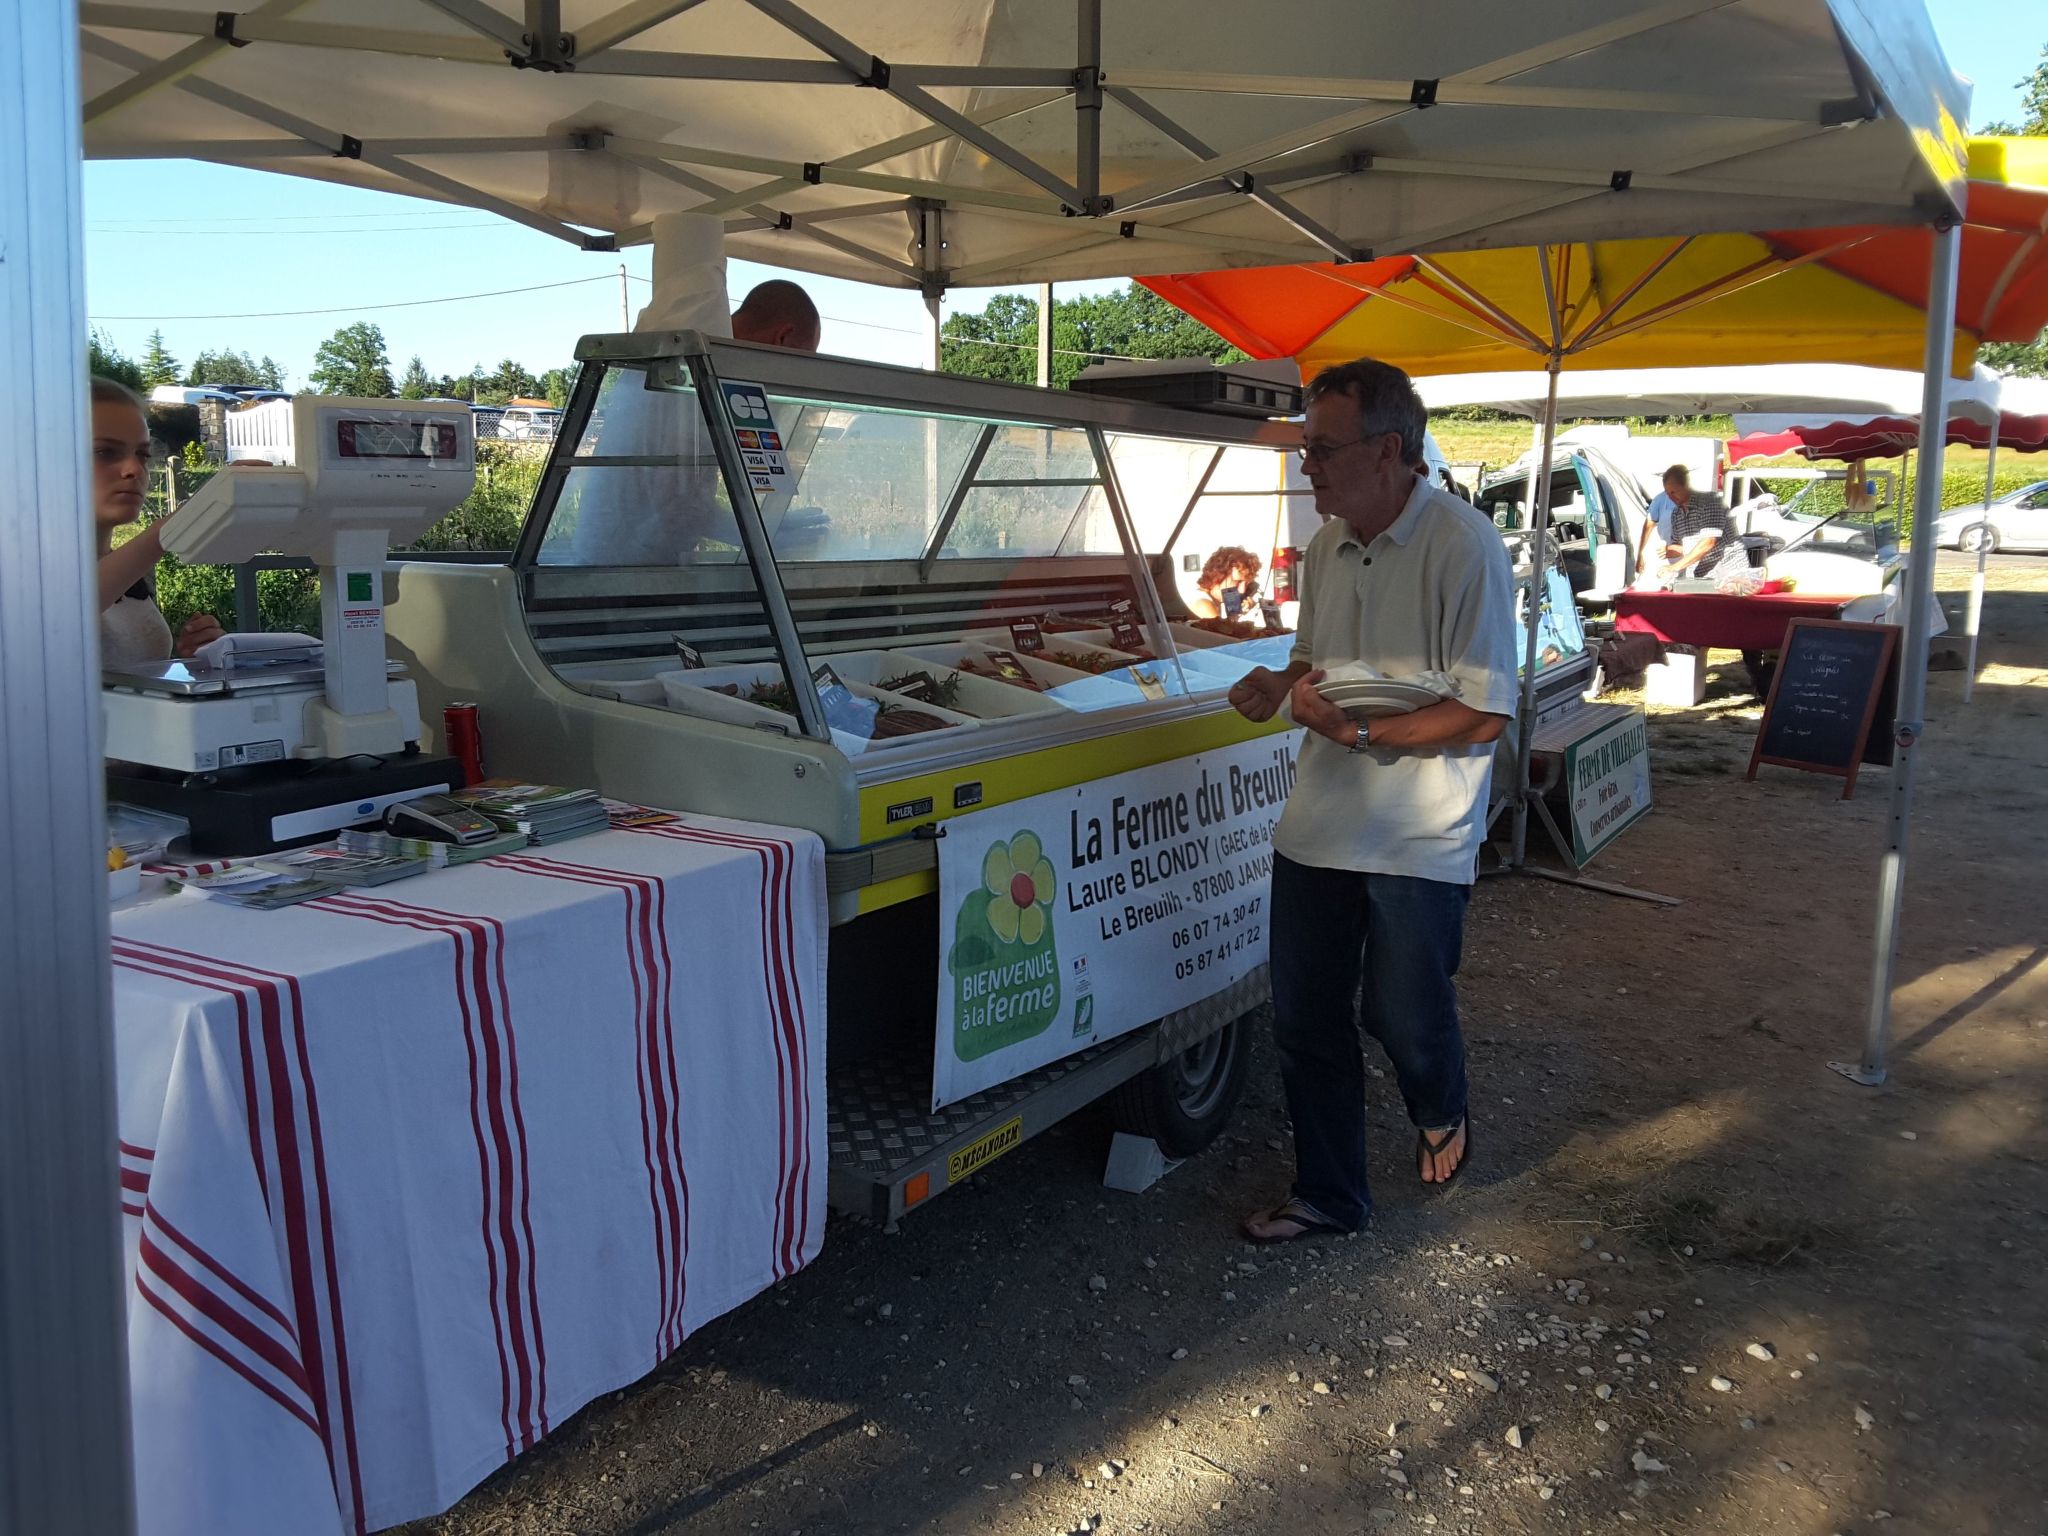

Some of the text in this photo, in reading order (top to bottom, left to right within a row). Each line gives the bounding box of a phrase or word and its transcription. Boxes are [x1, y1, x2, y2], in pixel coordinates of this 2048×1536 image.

[746, 455, 765, 465] VISA
[753, 476, 771, 486] VISA
[1578, 749, 1601, 792] FERME
[1601, 743, 1611, 777] DE
[892, 805, 914, 820] TYLER
[1071, 747, 1297, 869] La Ferme du Breuilh
[1067, 872, 1126, 912] Laure
[1130, 836, 1211, 889] BLONDY
[1250, 826, 1261, 847] de
[1260, 823, 1269, 842] la
[1100, 915, 1122, 940] Le
[1124, 891, 1183, 931] Breuilh
[1193, 870, 1235, 904] 87800
[1172, 897, 1261, 949] 06 07 74 30 47
[963, 950, 1055, 1002] BIENVENUE
[1175, 925, 1260, 980] 05 87 41 47 22
[962, 1009, 970, 1031] à
[972, 1006, 984, 1027] la
[986, 983, 1055, 1026] ferme
